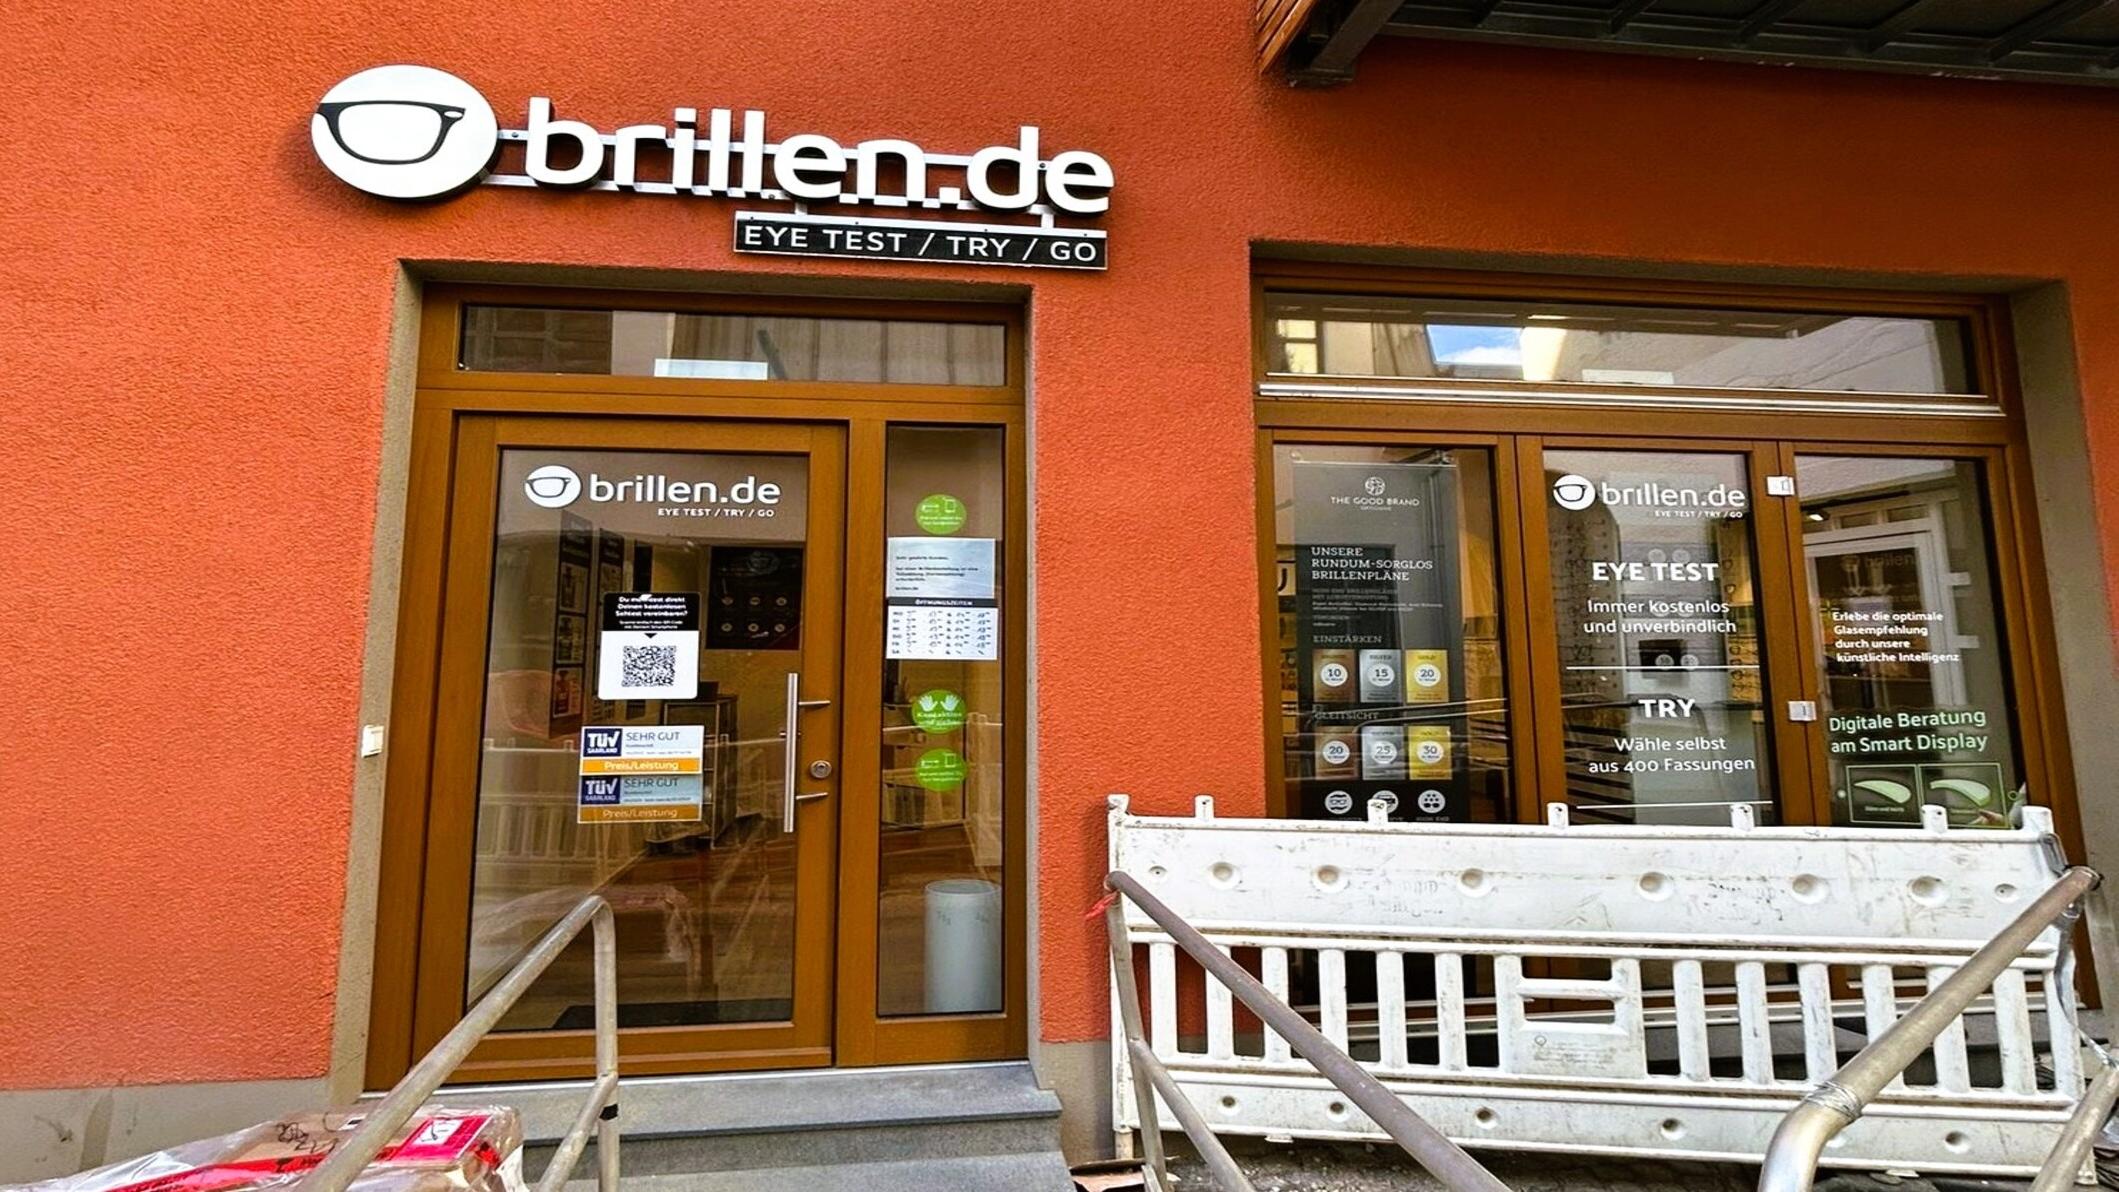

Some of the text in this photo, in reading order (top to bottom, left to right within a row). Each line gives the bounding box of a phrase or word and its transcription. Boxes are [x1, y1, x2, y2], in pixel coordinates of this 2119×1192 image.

[525, 97, 1114, 212] brillen.de
[744, 225, 808, 248] EYE
[822, 229, 907, 252] TEST
[946, 235, 1011, 258] TRY
[1050, 241, 1097, 262] GO
[589, 474, 781, 504] brillen.de
[1602, 482, 1746, 507] brillen.de
[1330, 496, 1420, 506] THE GOOD BRAND
[658, 508, 679, 516] EYE
[684, 508, 712, 517] TEST
[724, 508, 745, 517] TRY
[757, 509, 774, 517] GO
[1675, 510, 1695, 518] TEST
[1311, 547, 1363, 556] UNSERE
[1311, 559, 1433, 570] RUNDUM-SORGLOS
[1312, 571, 1410, 581] BRILLENPLÄNE
[1592, 562, 1719, 581] EYE TEST
[1588, 600, 1730, 613] Immer kostenlos
[1832, 612, 1943, 623] Erlebe die optimale
[1584, 619, 1737, 633] und unverbindlich
[1834, 625, 1928, 636] Glasempfehlung
[1835, 638, 1910, 648] durch unsere
[1836, 652, 1960, 664] künstliche Intelligenz
[1328, 669, 1341, 677] 10
[1375, 669, 1388, 677] 15
[1420, 669, 1434, 677] 20
[1638, 699, 1696, 718] TRY
[1829, 710, 1986, 733] Digitale Beratung
[587, 731, 620, 748] TÜV
[626, 732, 655, 741] SEHR
[658, 732, 680, 740] GUT
[1614, 737, 1727, 751] Wähle selbst
[1831, 734, 1988, 753] am Smart Display
[1329, 746, 1343, 754] 20
[1376, 746, 1390, 754] 25
[1423, 746, 1437, 754] 30
[604, 761, 679, 770] Preis/Leistung
[1588, 758, 1756, 774] aus 400 Fassungen
[585, 778, 617, 795] TÜV
[624, 778, 655, 787] SEHR
[656, 778, 679, 787] GUT
[602, 809, 678, 818] Preis/Leistung
